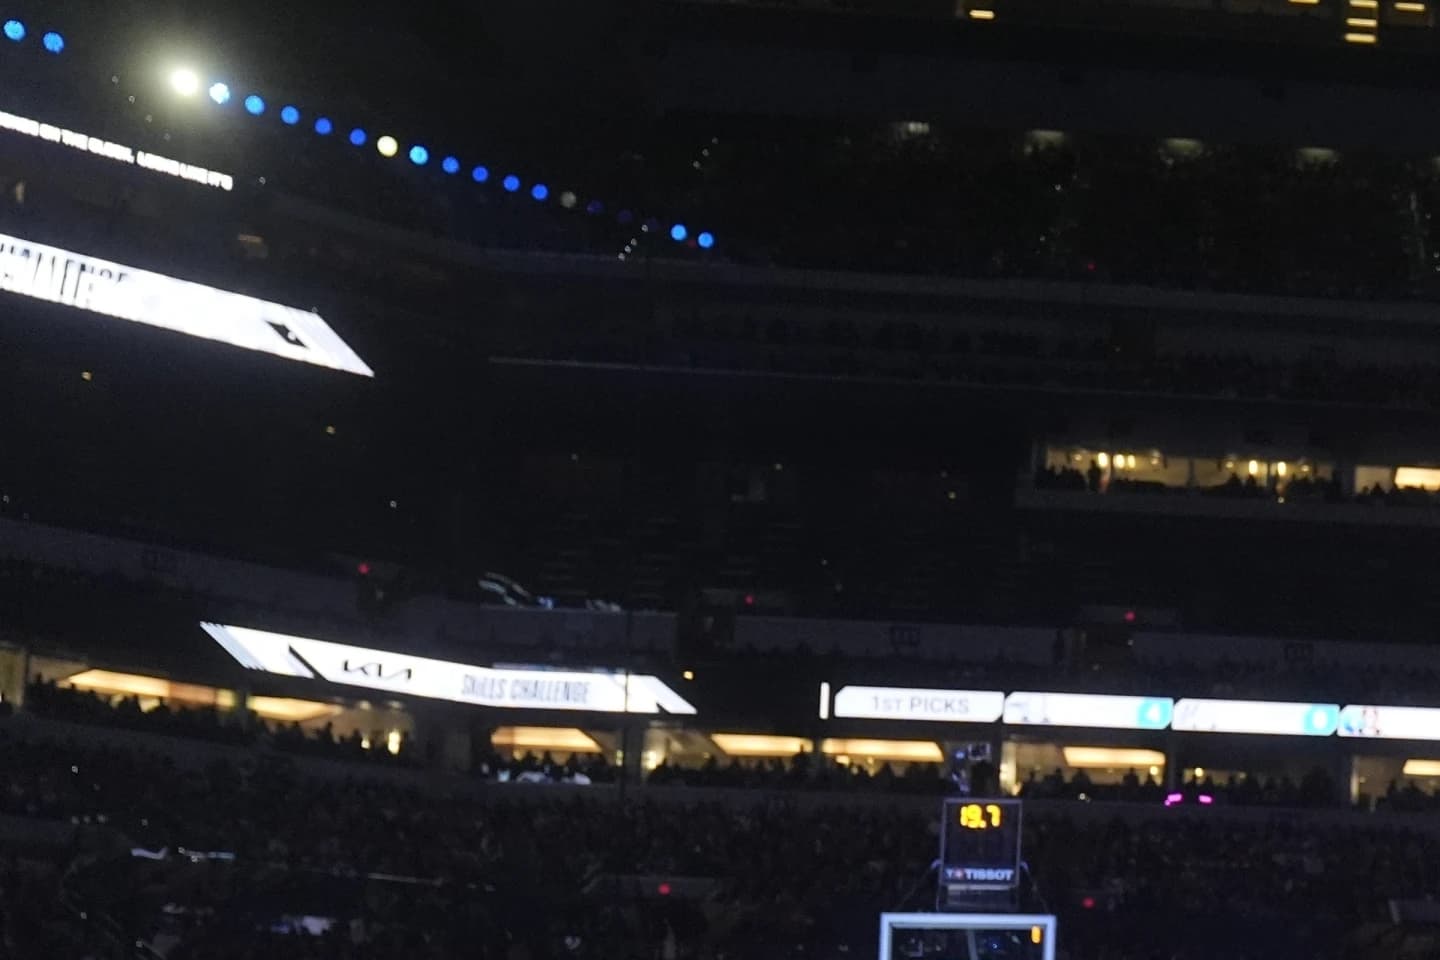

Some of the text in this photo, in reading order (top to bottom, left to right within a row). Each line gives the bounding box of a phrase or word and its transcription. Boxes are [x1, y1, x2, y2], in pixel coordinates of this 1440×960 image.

[343, 659, 412, 680] KIA
[510, 679, 591, 704] CHALLENGE
[910, 696, 969, 714] PICKS
[965, 868, 1014, 880] TISSOT
